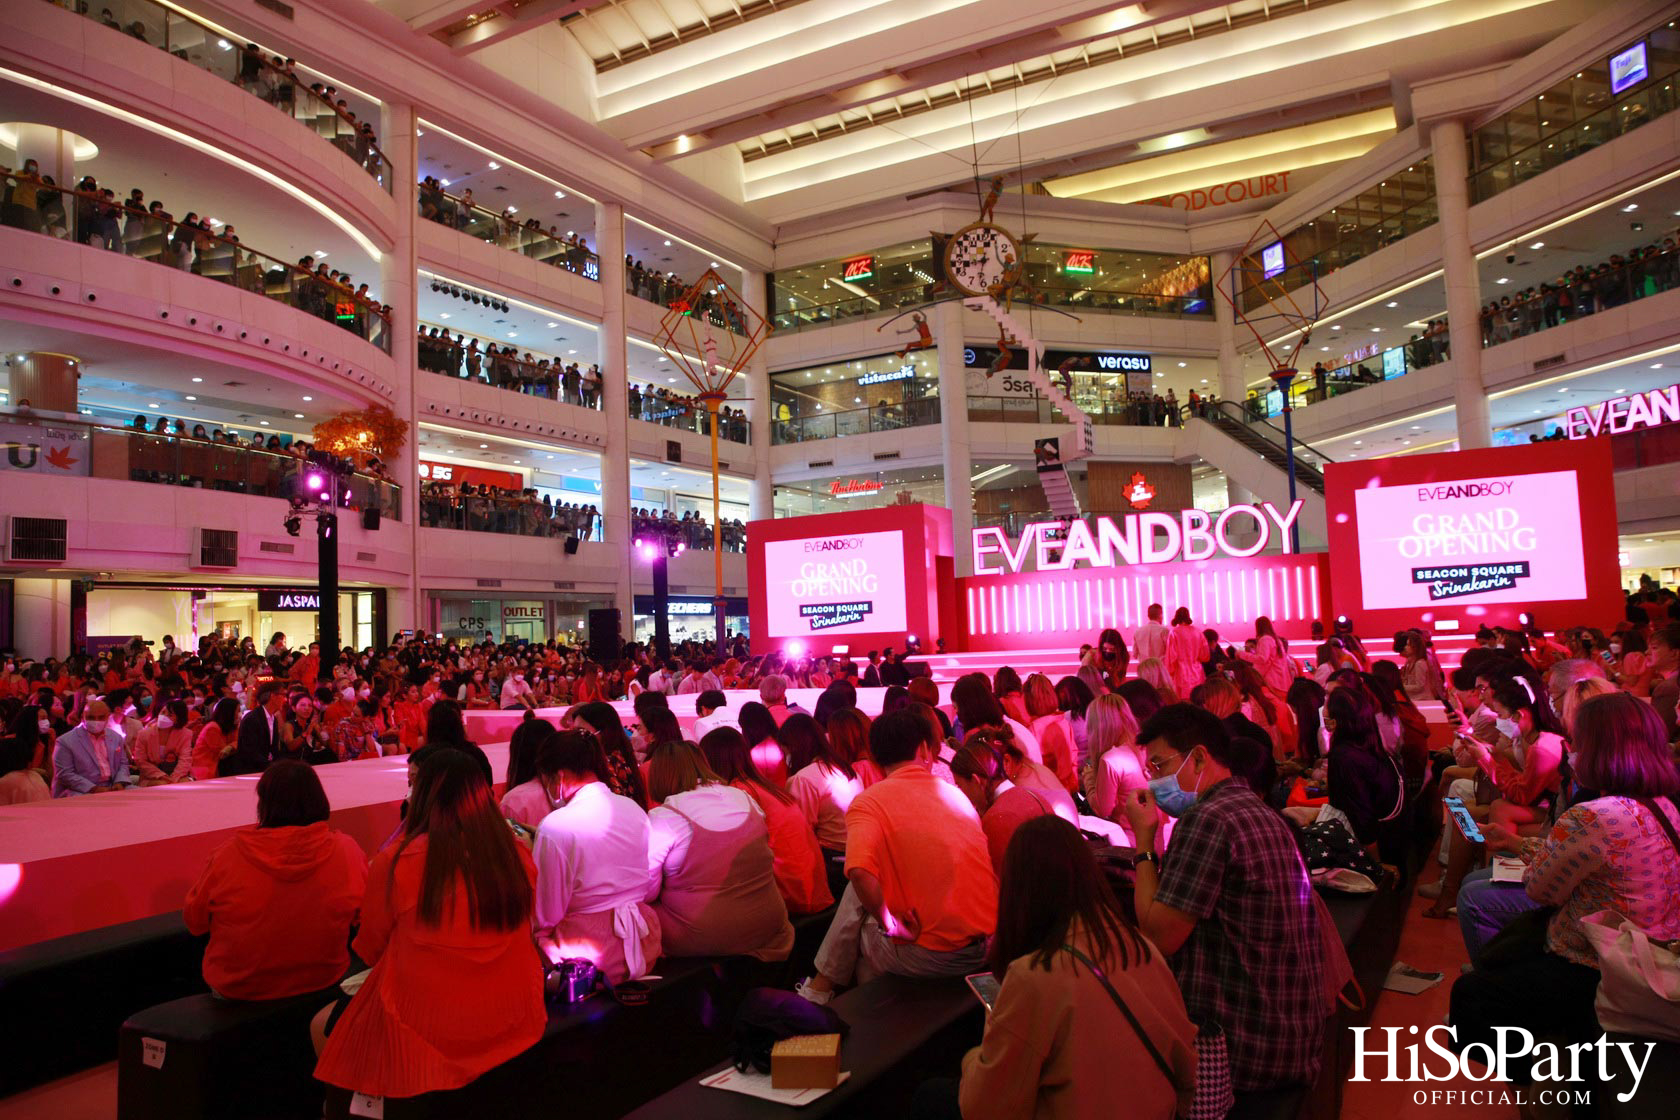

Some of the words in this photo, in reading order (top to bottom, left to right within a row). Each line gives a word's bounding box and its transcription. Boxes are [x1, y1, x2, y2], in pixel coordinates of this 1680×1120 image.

[1138, 171, 1291, 211] ODCOURT
[1001, 243, 1008, 253] 2
[845, 259, 871, 277] MK
[1067, 254, 1093, 268] MK
[968, 276, 975, 286] 7
[980, 278, 987, 288] 6
[1097, 356, 1149, 370] verasu
[431, 466, 453, 481] 5G
[1418, 480, 1514, 501] EVEANDBOY
[1412, 507, 1520, 535] GRAND
[804, 538, 864, 552] EVEANDBOY
[971, 499, 1305, 576] EVEANDBOY
[1397, 527, 1537, 559] OPENING
[801, 558, 867, 580] GRAND
[1416, 567, 1468, 580] SEACON
[1471, 564, 1523, 578] SQUARE
[791, 574, 878, 598] OPENING
[1432, 575, 1511, 597] Srinakarin
[503, 606, 543, 617] OUTLET
[802, 605, 835, 614] SEACON
[836, 603, 869, 613] SQUARE
[459, 617, 484, 630] CPS
[812, 610, 861, 628] Srinakarin
